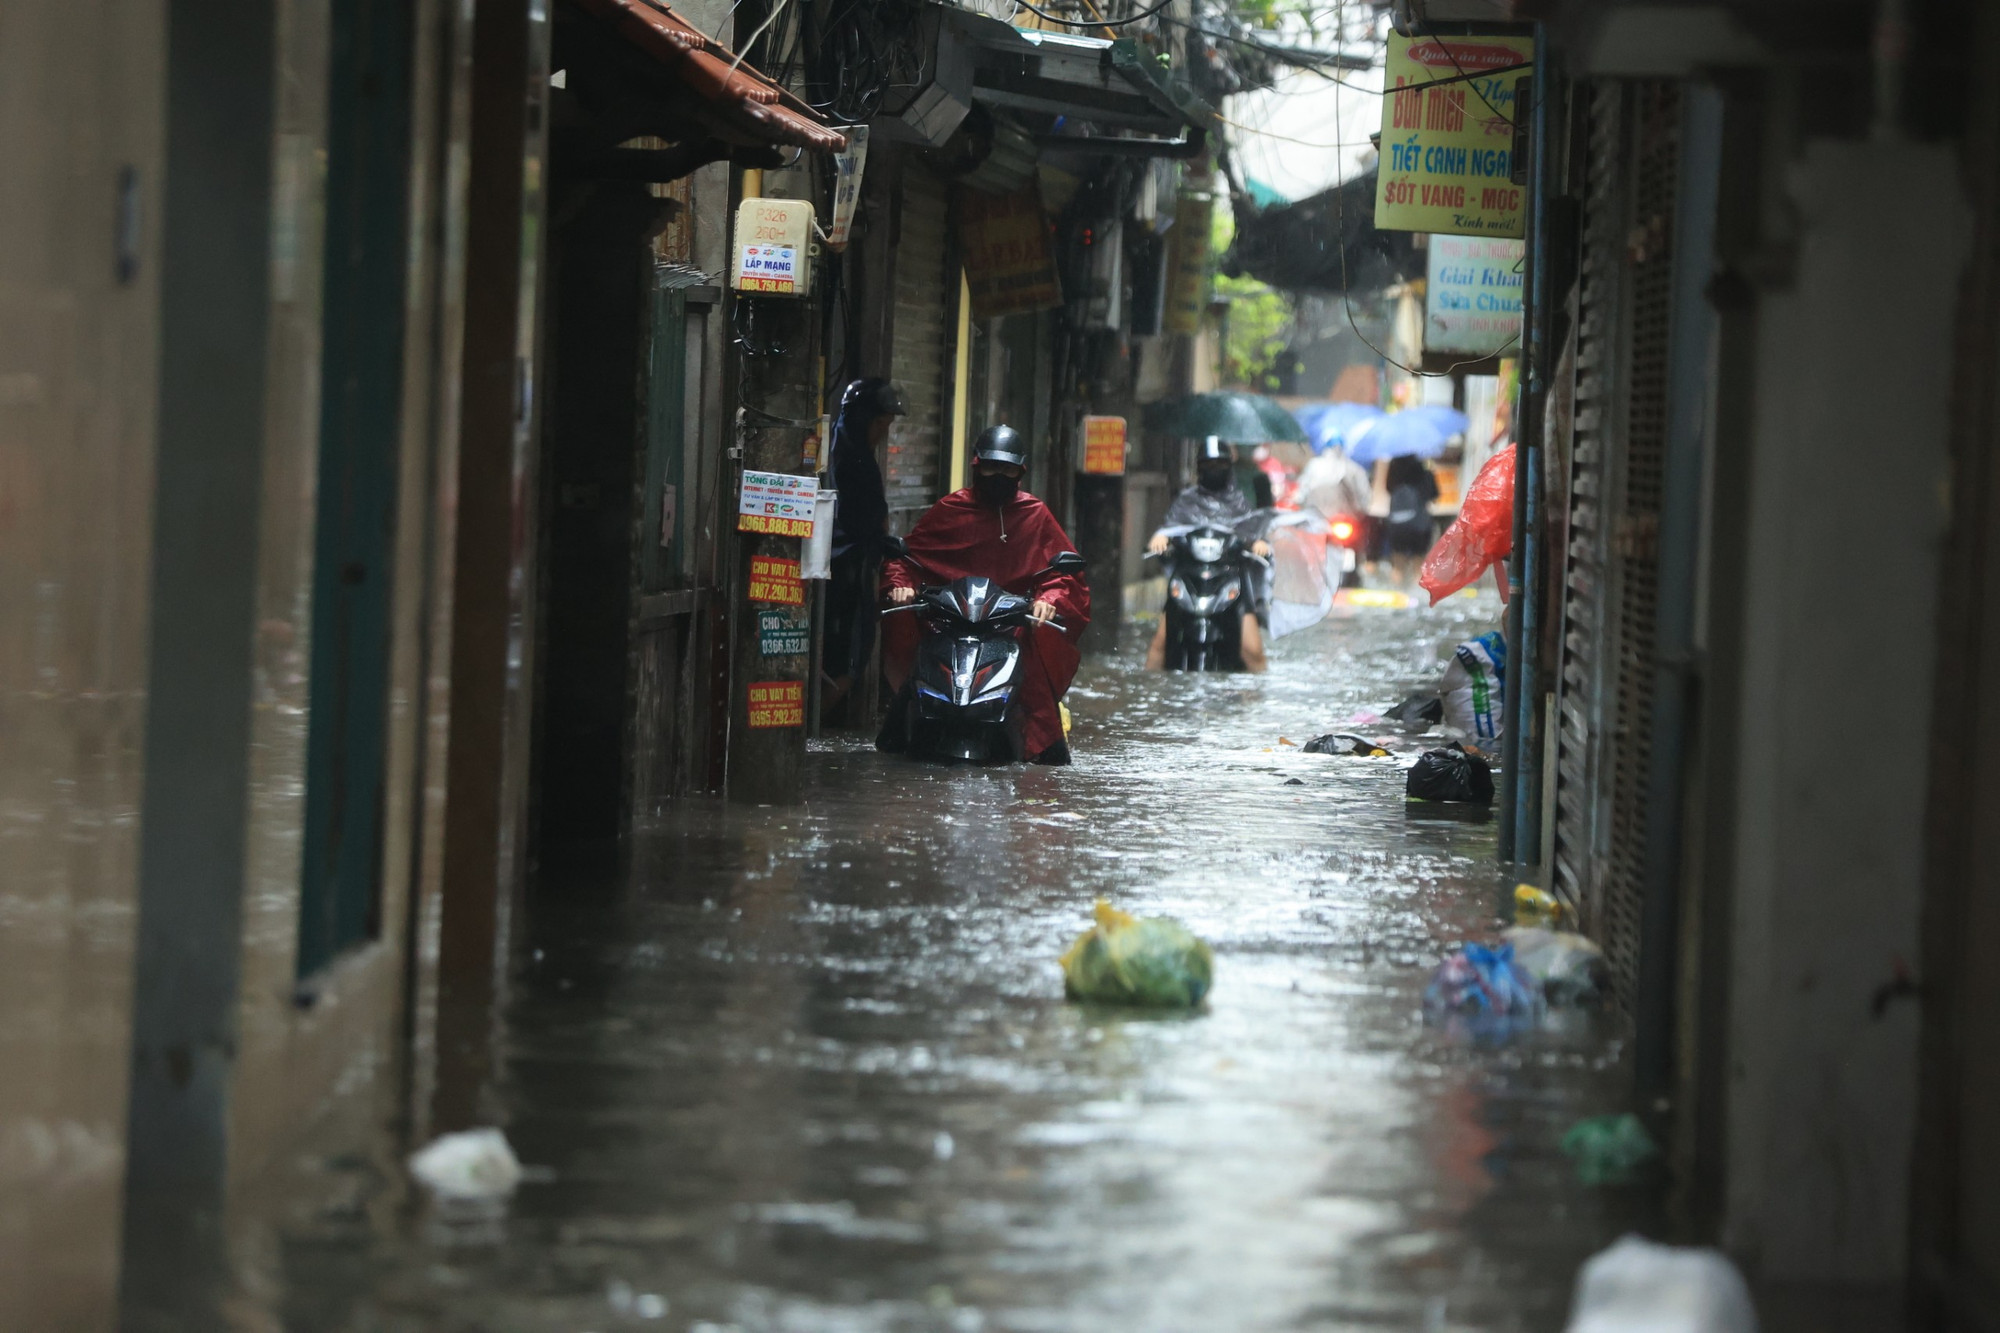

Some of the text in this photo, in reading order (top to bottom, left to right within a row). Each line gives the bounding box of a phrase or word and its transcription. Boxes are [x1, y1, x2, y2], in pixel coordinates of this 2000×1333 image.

[1482, 51, 1515, 65] sáng
[1393, 75, 1424, 129] Bún
[1391, 134, 1422, 172] TIẾT
[1425, 146, 1467, 176] CANH
[1384, 175, 1417, 205] SỐT
[1421, 184, 1465, 208] VANG
[1481, 188, 1520, 215] MỌC
[1452, 213, 1484, 229] Kính
[745, 256, 792, 273] LẮP MẠNG
[739, 515, 812, 537] 0966.886.803
[753, 561, 769, 574] CHO
[771, 563, 787, 576] VAY
[762, 617, 780, 630] CHO
[750, 688, 767, 702] CHO
[769, 688, 785, 701] VAY
